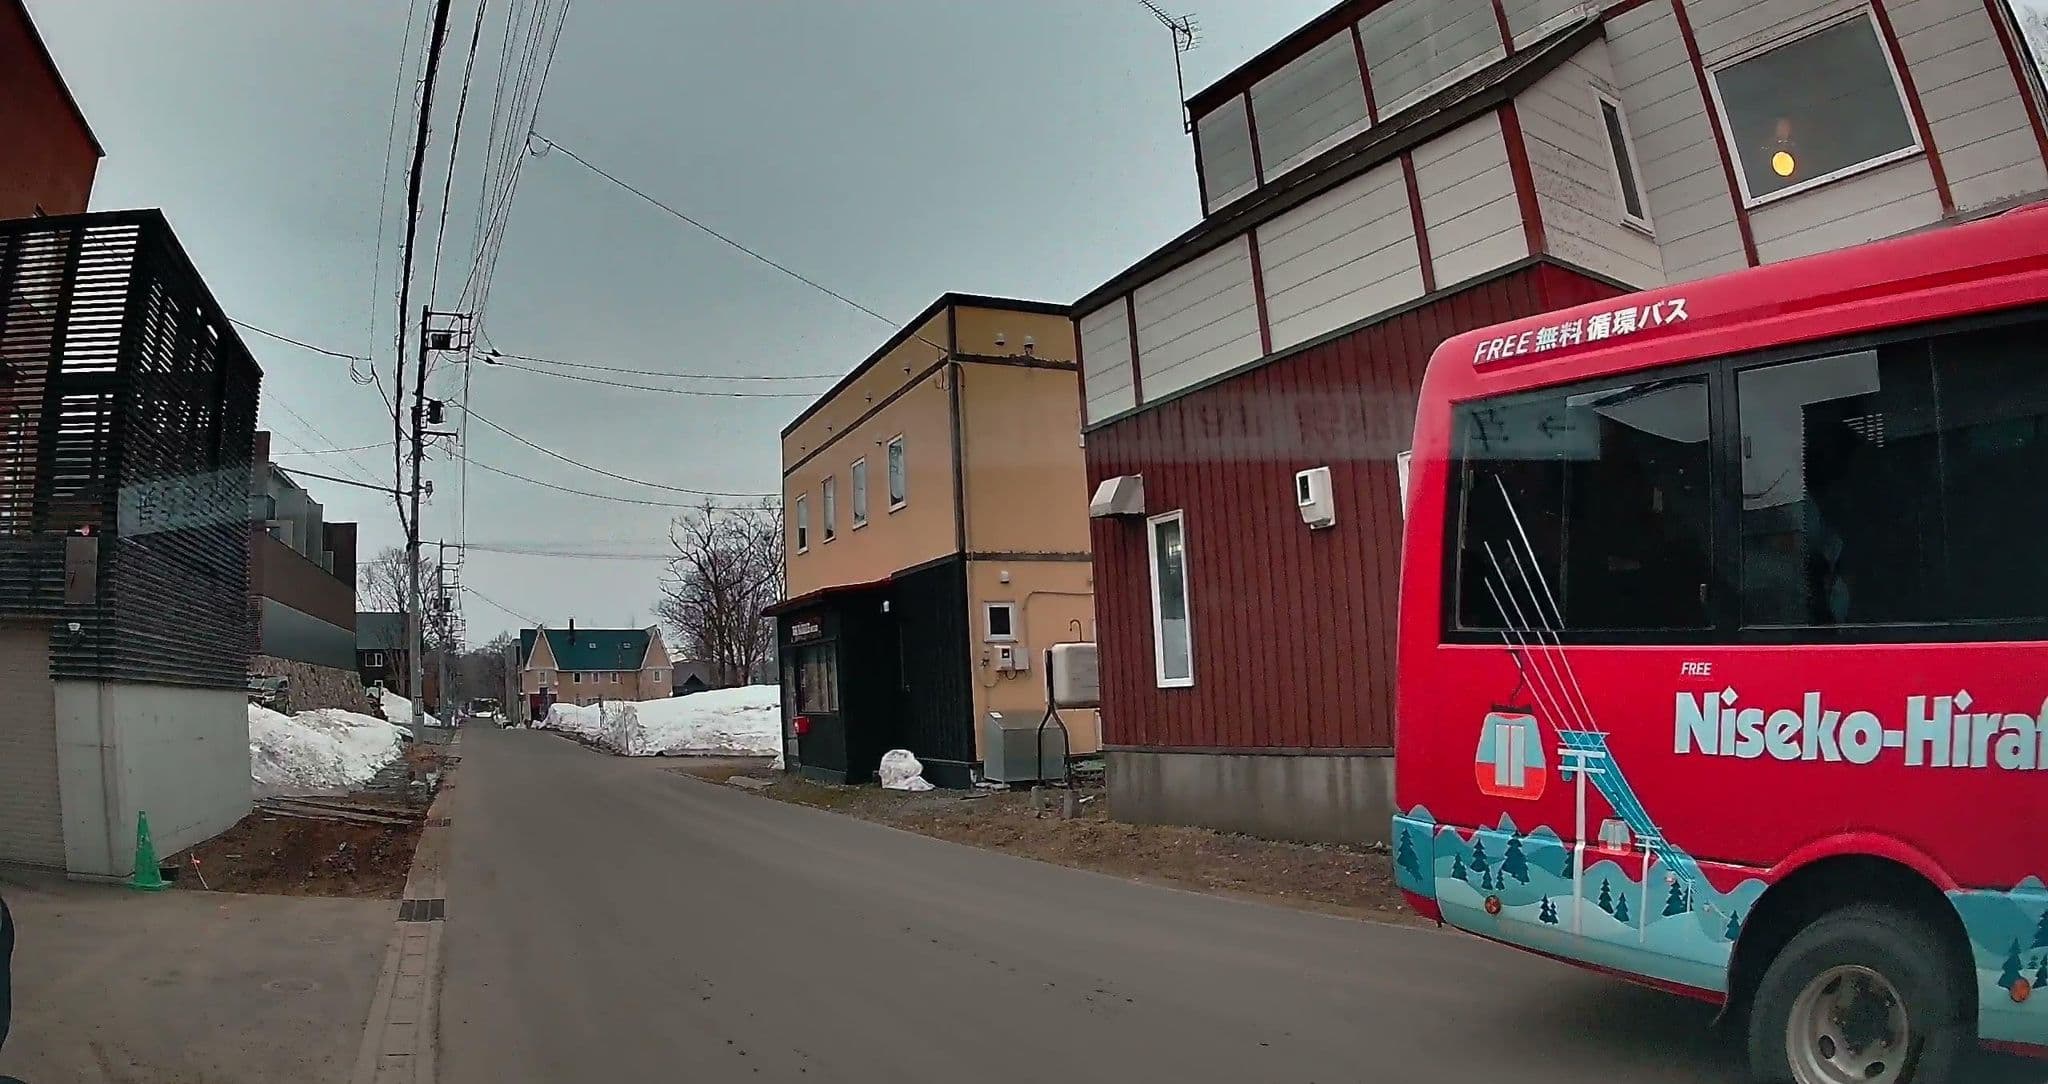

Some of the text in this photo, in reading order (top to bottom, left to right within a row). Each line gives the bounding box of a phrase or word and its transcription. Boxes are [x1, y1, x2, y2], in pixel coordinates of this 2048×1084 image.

[1473, 298, 1688, 363] FREE 無料 循環バス
[1681, 661, 1712, 676] FREE
